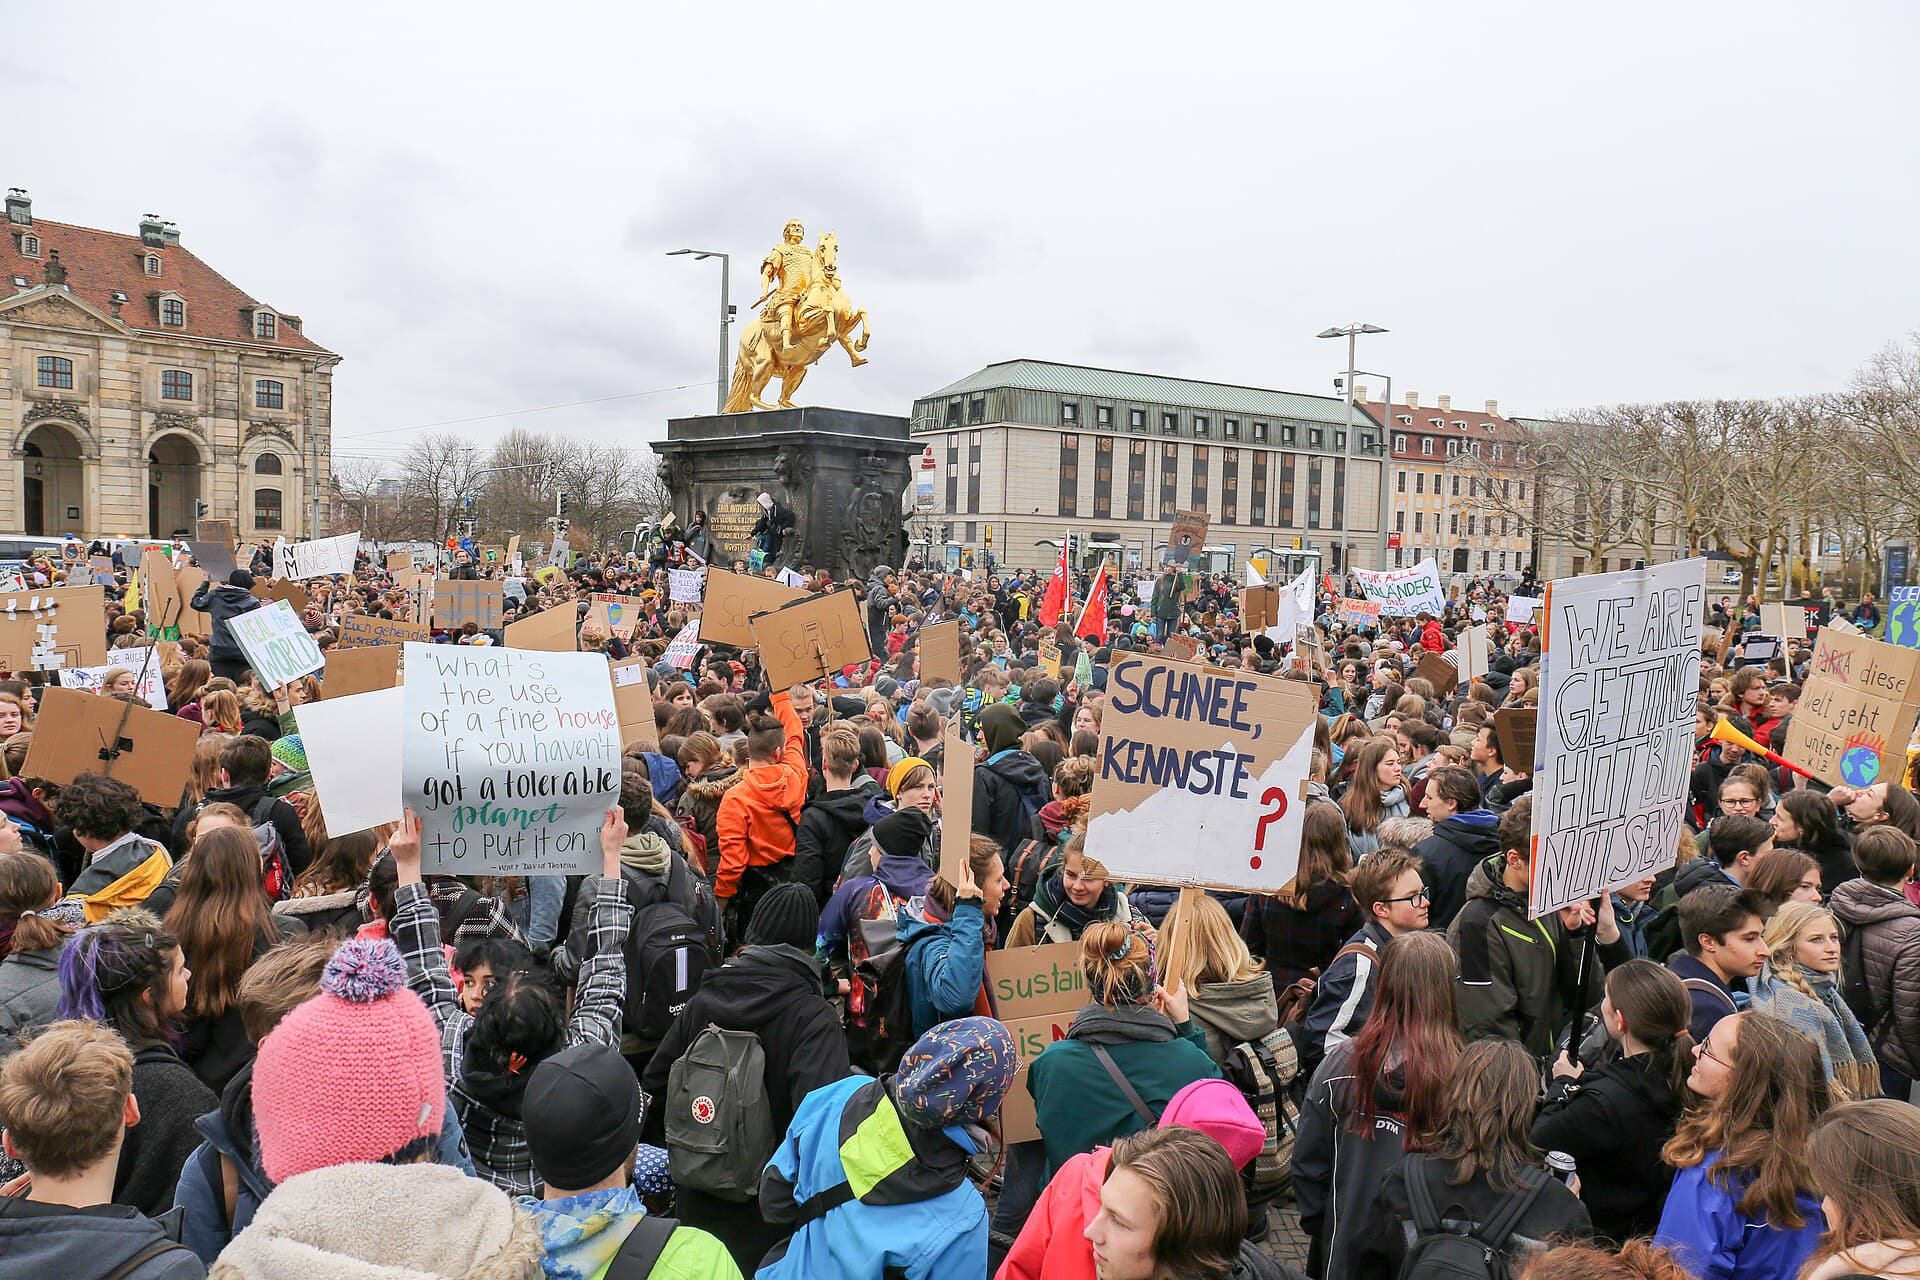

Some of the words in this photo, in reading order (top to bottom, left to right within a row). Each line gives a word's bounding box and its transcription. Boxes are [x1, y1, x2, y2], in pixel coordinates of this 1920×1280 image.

[1385, 569, 1421, 583] ALLE
[597, 593, 617, 603] THERE
[622, 596, 630, 605] IS
[1803, 610, 1819, 619] CK
[238, 615, 276, 646] HEAL
[271, 611, 294, 632] the
[344, 615, 371, 633] Euch
[374, 624, 410, 639] gehen
[411, 629, 429, 641] die
[1564, 596, 1634, 670] WE
[1638, 584, 1701, 655] ARE
[253, 631, 319, 682] WORLD
[1860, 657, 1907, 693] diese
[440, 682, 495, 705] the
[509, 683, 562, 704] use
[1111, 660, 1262, 740] SCHNEE,
[1555, 649, 1701, 752] GETTING
[466, 713, 483, 732] a
[493, 706, 548, 738] fine
[555, 706, 616, 730] house
[1832, 702, 1880, 733] geht
[533, 733, 616, 763] haven't
[1804, 733, 1841, 759] unter
[1101, 736, 1255, 800] KENNSTE
[1551, 733, 1650, 836] HOT
[1639, 720, 1697, 810] BUT
[423, 774, 466, 811] got
[480, 776, 496, 801] a
[503, 767, 618, 800] tolerable
[452, 801, 568, 834] planet
[427, 829, 467, 864] to
[534, 827, 552, 859] it
[1539, 815, 1627, 914] NOT
[1609, 802, 1683, 883] SEXY
[1019, 1027, 1045, 1057] is
[1375, 1120, 1399, 1135] DTM
